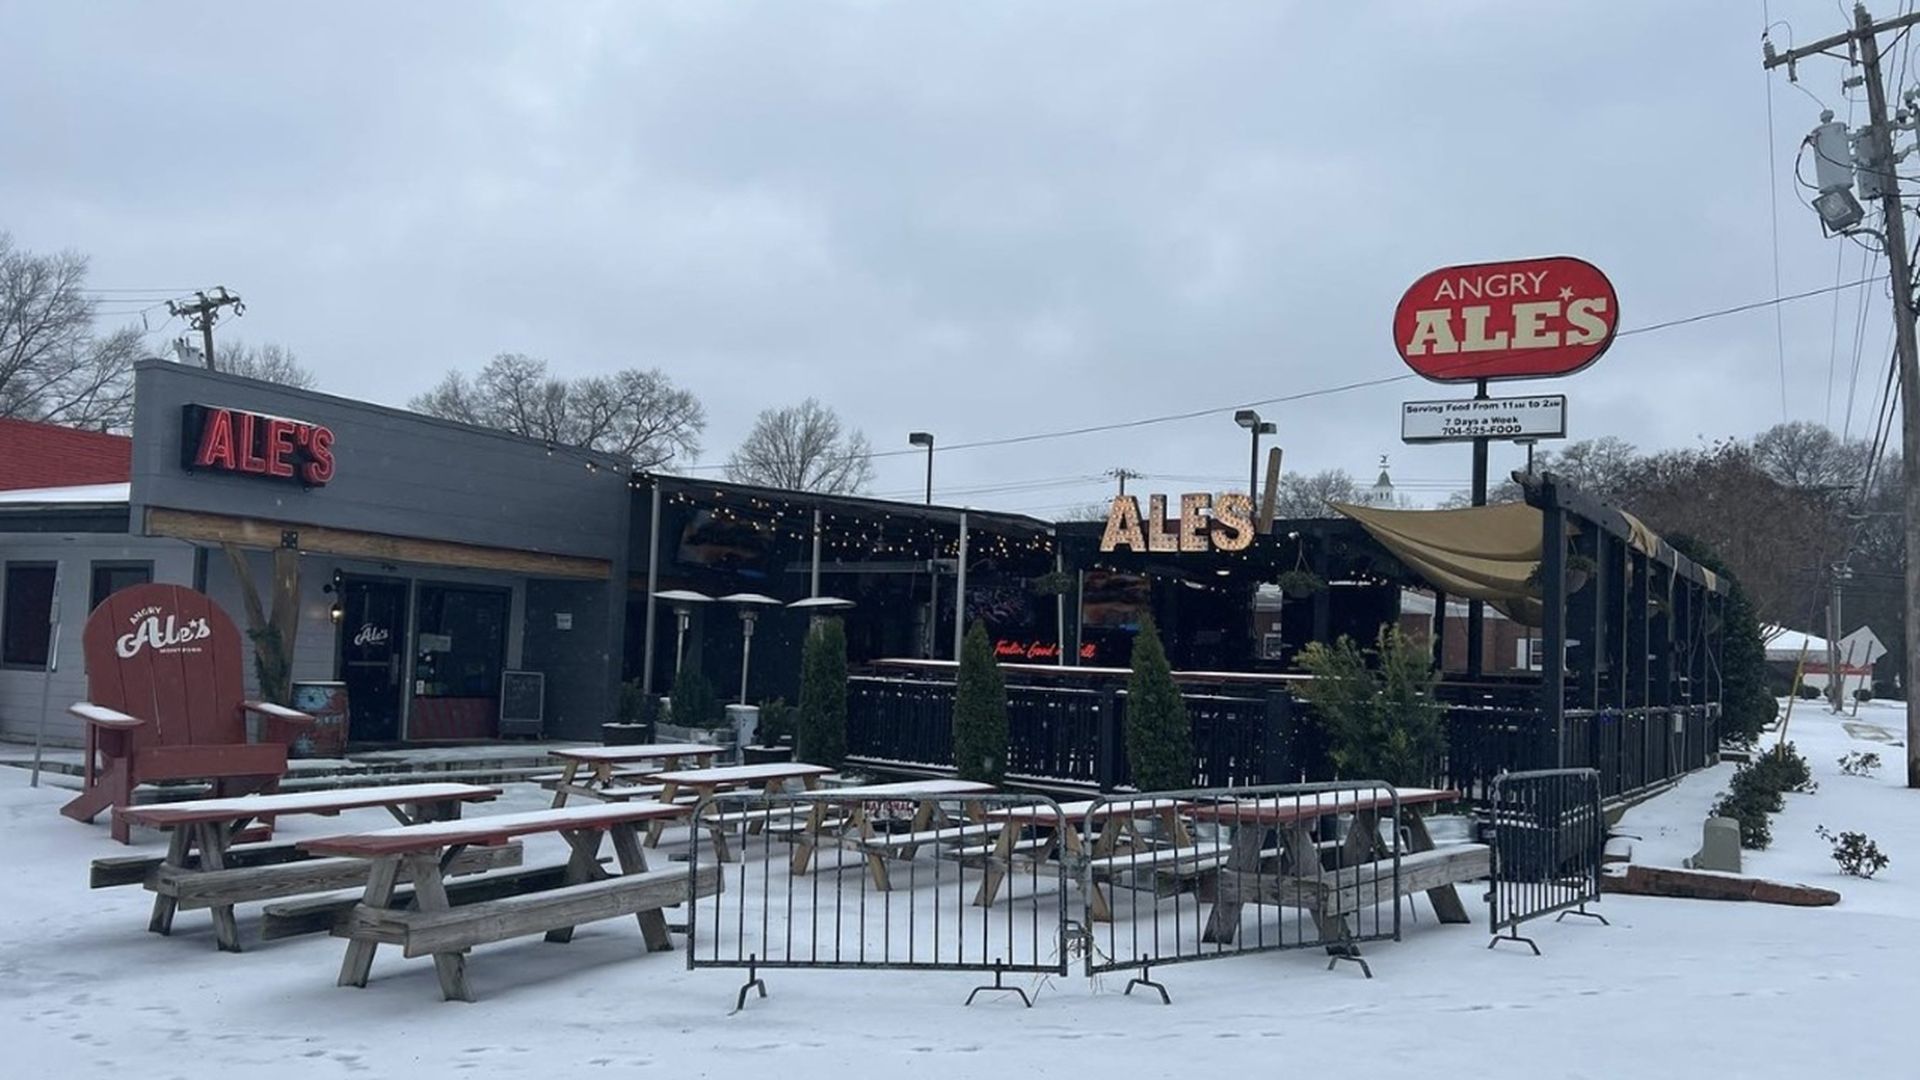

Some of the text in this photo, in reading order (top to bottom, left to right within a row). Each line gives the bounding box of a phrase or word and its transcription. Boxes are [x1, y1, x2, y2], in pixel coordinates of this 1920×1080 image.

[1434, 270, 1549, 302] ANGRY
[1406, 405, 1443, 413] Serving
[1446, 403, 1470, 411] Food
[1473, 402, 1499, 410] From
[1442, 425, 1522, 435] 704-525-FOOD
[1445, 418, 1451, 426] 7
[1454, 418, 1479, 427] Days
[1491, 416, 1519, 424] Week
[202, 408, 335, 483] ALE'S
[1100, 493, 1256, 552] ALES
[129, 605, 162, 625] ANGRY
